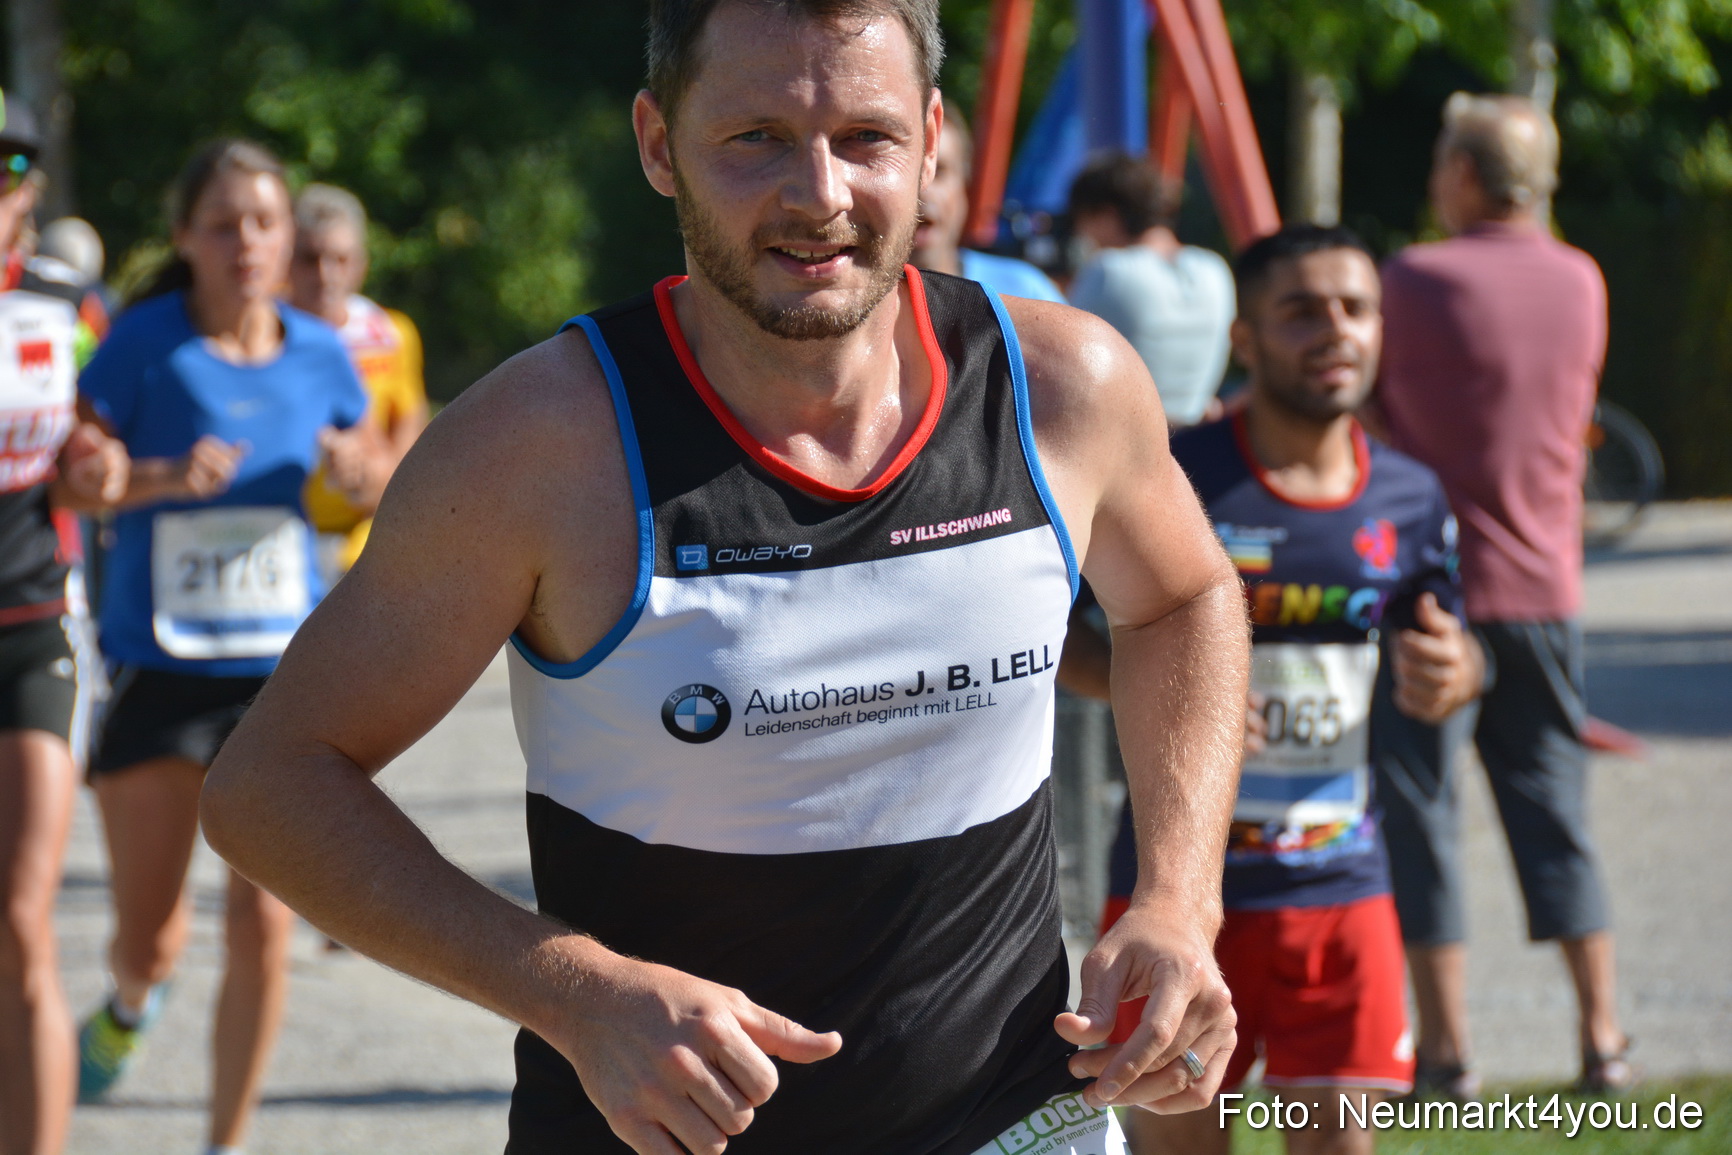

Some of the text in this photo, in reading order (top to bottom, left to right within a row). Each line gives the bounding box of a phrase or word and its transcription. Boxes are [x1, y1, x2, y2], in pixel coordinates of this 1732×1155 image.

[890, 508, 1012, 546] SV ILLSCHWANG
[668, 685, 725, 705] BMW
[743, 644, 1054, 716] Autohaus J. B. LELL
[744, 692, 998, 737] Leidenschaft beginnt mit LELL
[1066, 1126, 1089, 1141] smart
